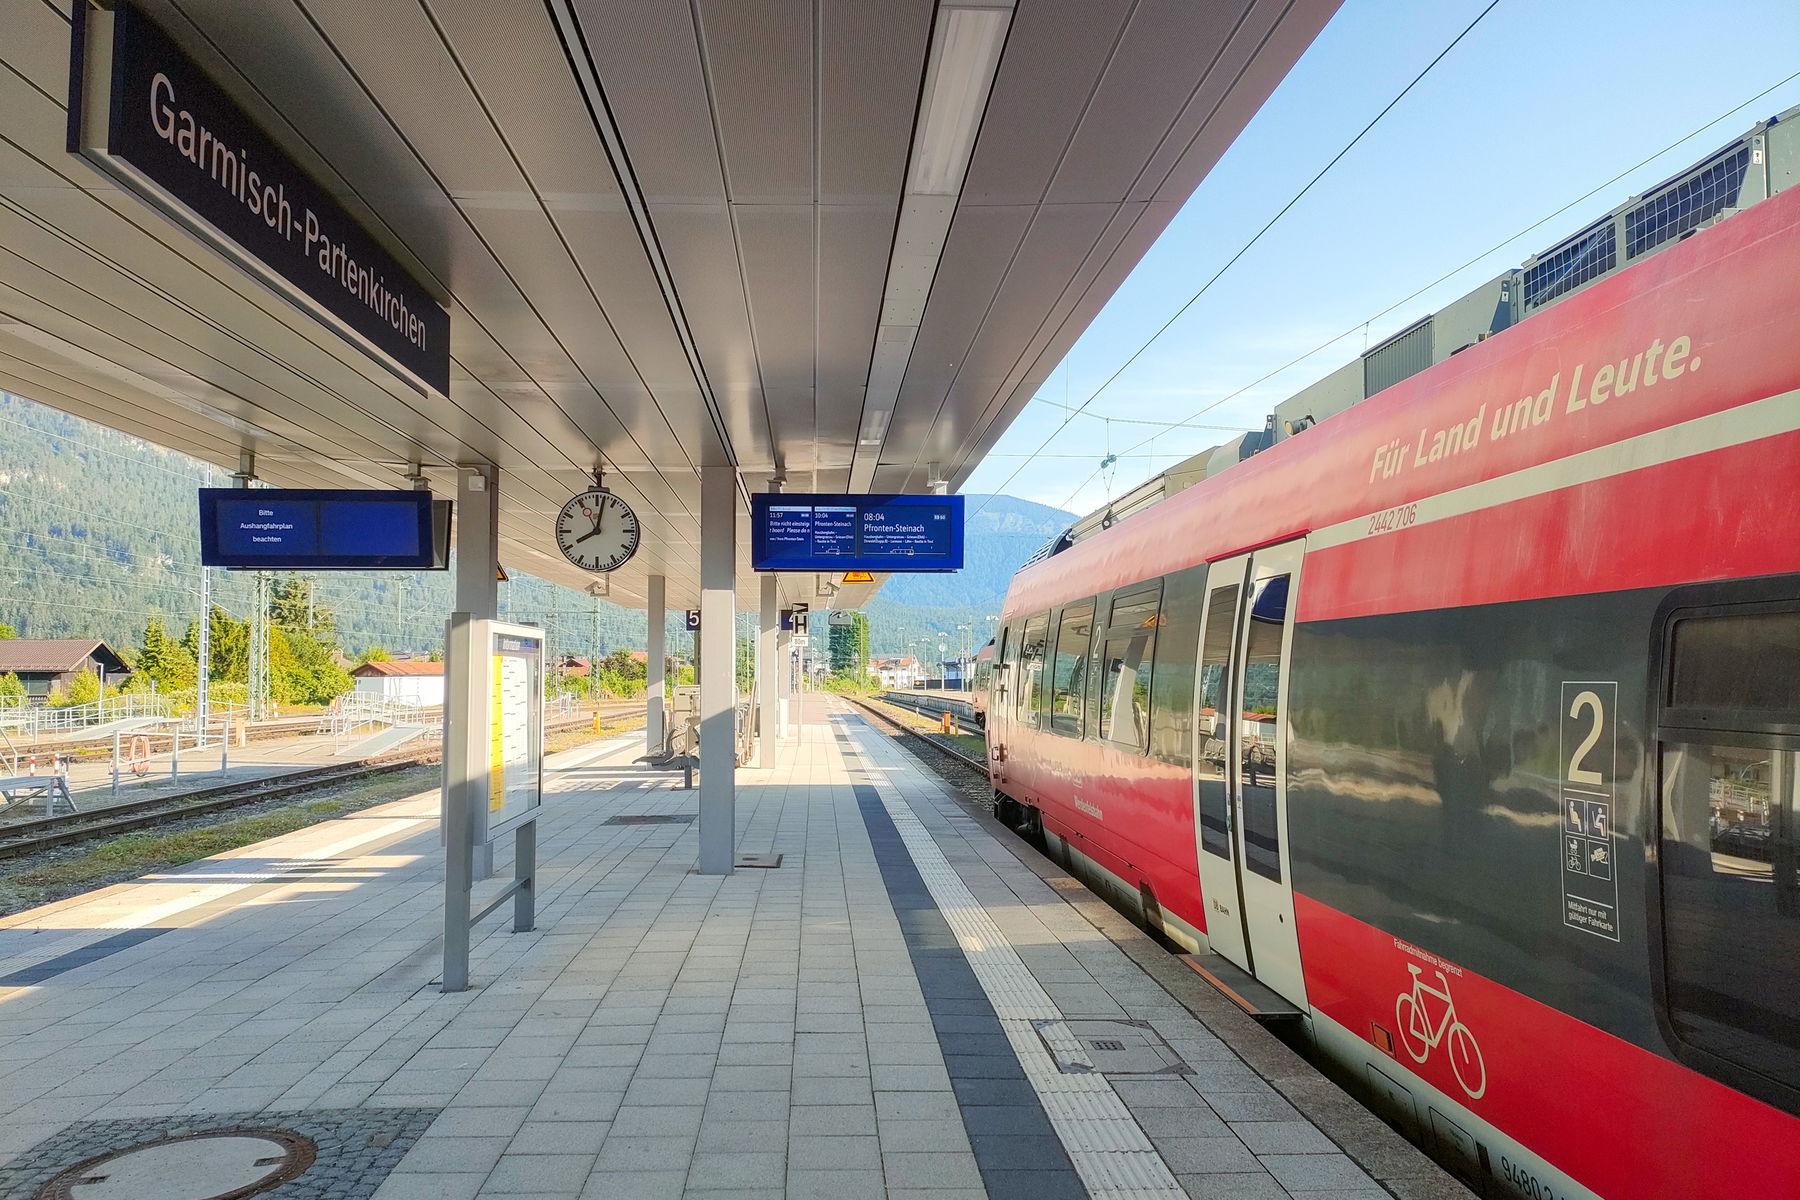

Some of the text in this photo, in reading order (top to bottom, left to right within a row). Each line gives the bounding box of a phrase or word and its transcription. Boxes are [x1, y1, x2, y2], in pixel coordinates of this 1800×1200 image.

[150, 71, 427, 353] Garmisch-Partenkirchen
[1369, 335, 1702, 484] Für Land und Leute.
[240, 522, 293, 530] Aushangfahrplan
[864, 512, 885, 521] 08:04
[1368, 503, 1417, 535] 2442 706
[864, 524, 925, 532] Pfronten-Steinach
[689, 610, 699, 626] 5
[795, 616, 807, 634] H
[1568, 691, 1604, 785] 2
[1568, 900, 1588, 914] Mitfahrt
[1598, 910, 1607, 920] mit
[1568, 911, 1613, 932] gültiger Fahrkarte
[1394, 938, 1463, 978] Fahrradmitnahme begrenzt
